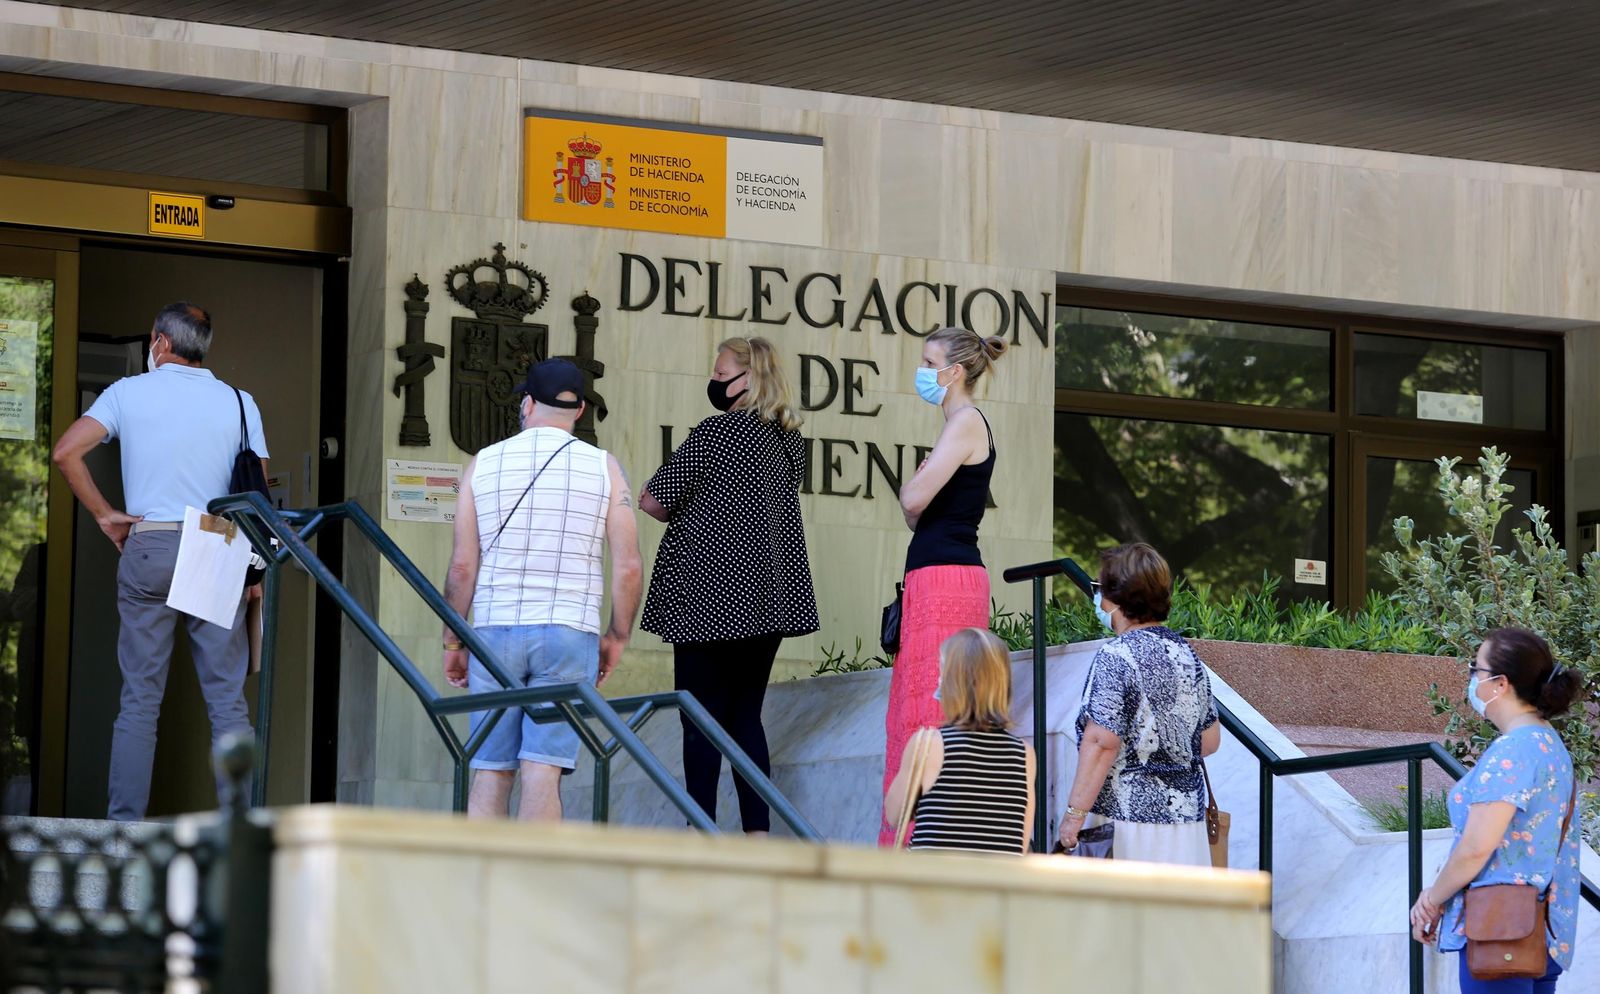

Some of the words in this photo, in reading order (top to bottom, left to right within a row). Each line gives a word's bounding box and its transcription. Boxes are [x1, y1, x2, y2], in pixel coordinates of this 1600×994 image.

[629, 152, 691, 169] MINISTERIO
[629, 166, 644, 177] DE
[647, 168, 705, 184] HACIENDA
[736, 171, 800, 187] DELEGACIÓN
[629, 187, 691, 202] MINISTERIO
[736, 184, 748, 195] DE
[750, 186, 807, 200] ECONOMÍA
[629, 200, 644, 211] DE
[647, 201, 709, 218] ECONOMÍA
[736, 197, 743, 207] Y
[745, 198, 796, 212] HACIENDA
[154, 203, 200, 227] ENTRADA
[617, 252, 1052, 348] DELEGACION
[797, 353, 882, 417] DE
